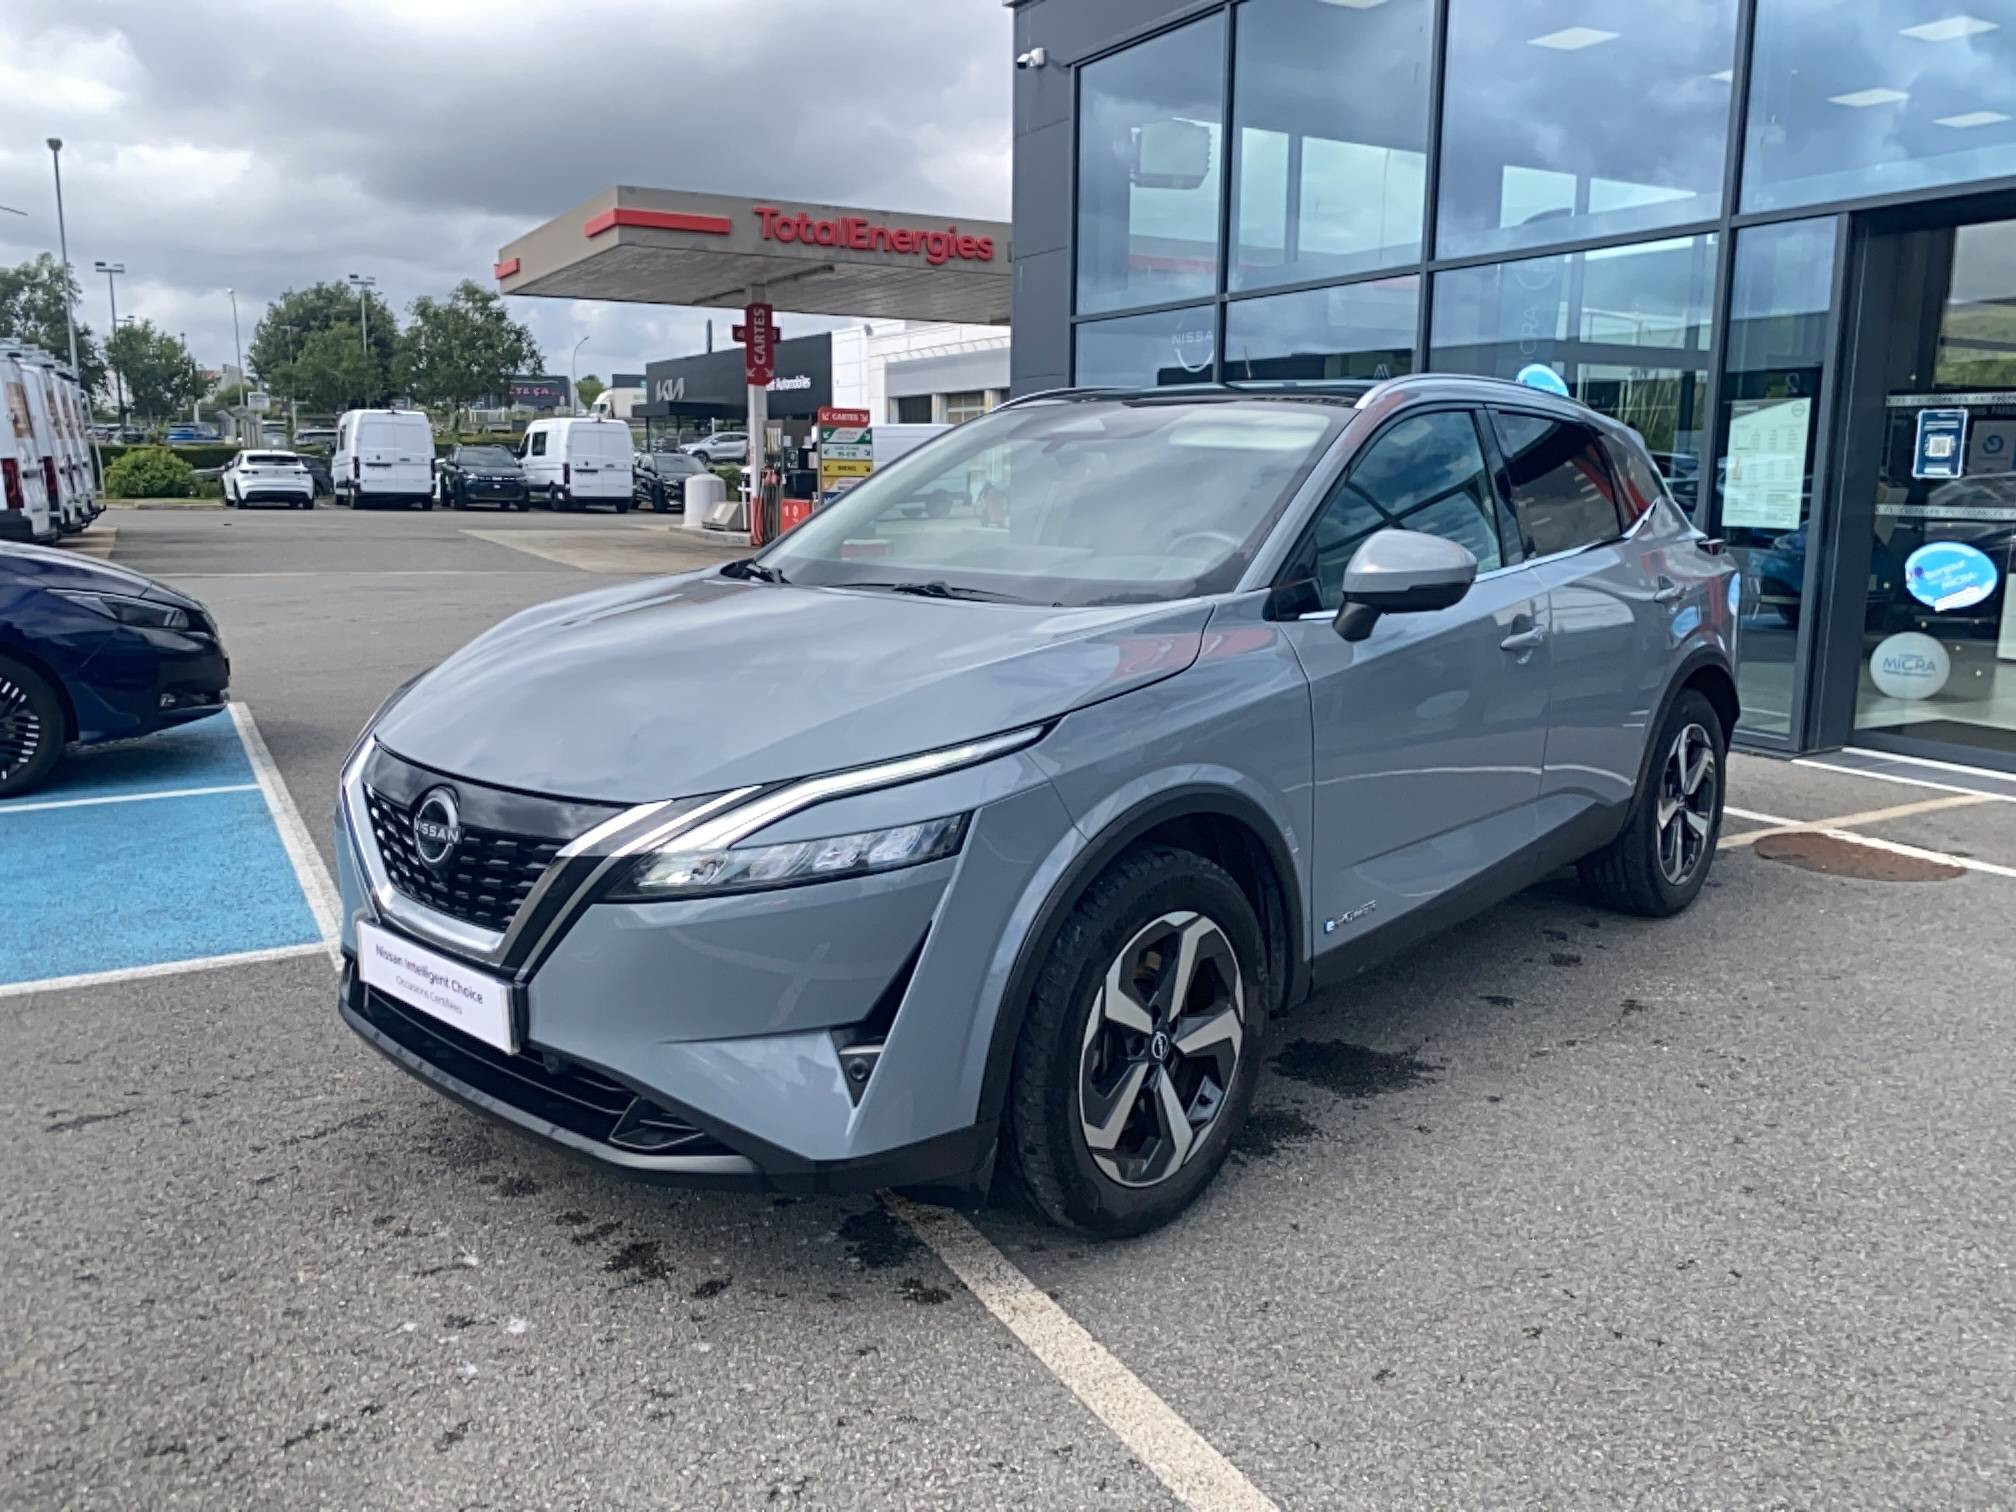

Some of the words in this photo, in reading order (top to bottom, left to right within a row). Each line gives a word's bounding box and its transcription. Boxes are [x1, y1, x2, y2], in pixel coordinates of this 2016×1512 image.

[753, 204, 993, 265] TotalEnergies
[753, 308, 766, 365] CARTES
[1171, 330, 1213, 345] NISSA
[414, 819, 460, 844] NISSAN
[375, 943, 404, 967] Nissan
[404, 958, 450, 988] Intelligent
[451, 979, 483, 1005] Choice
